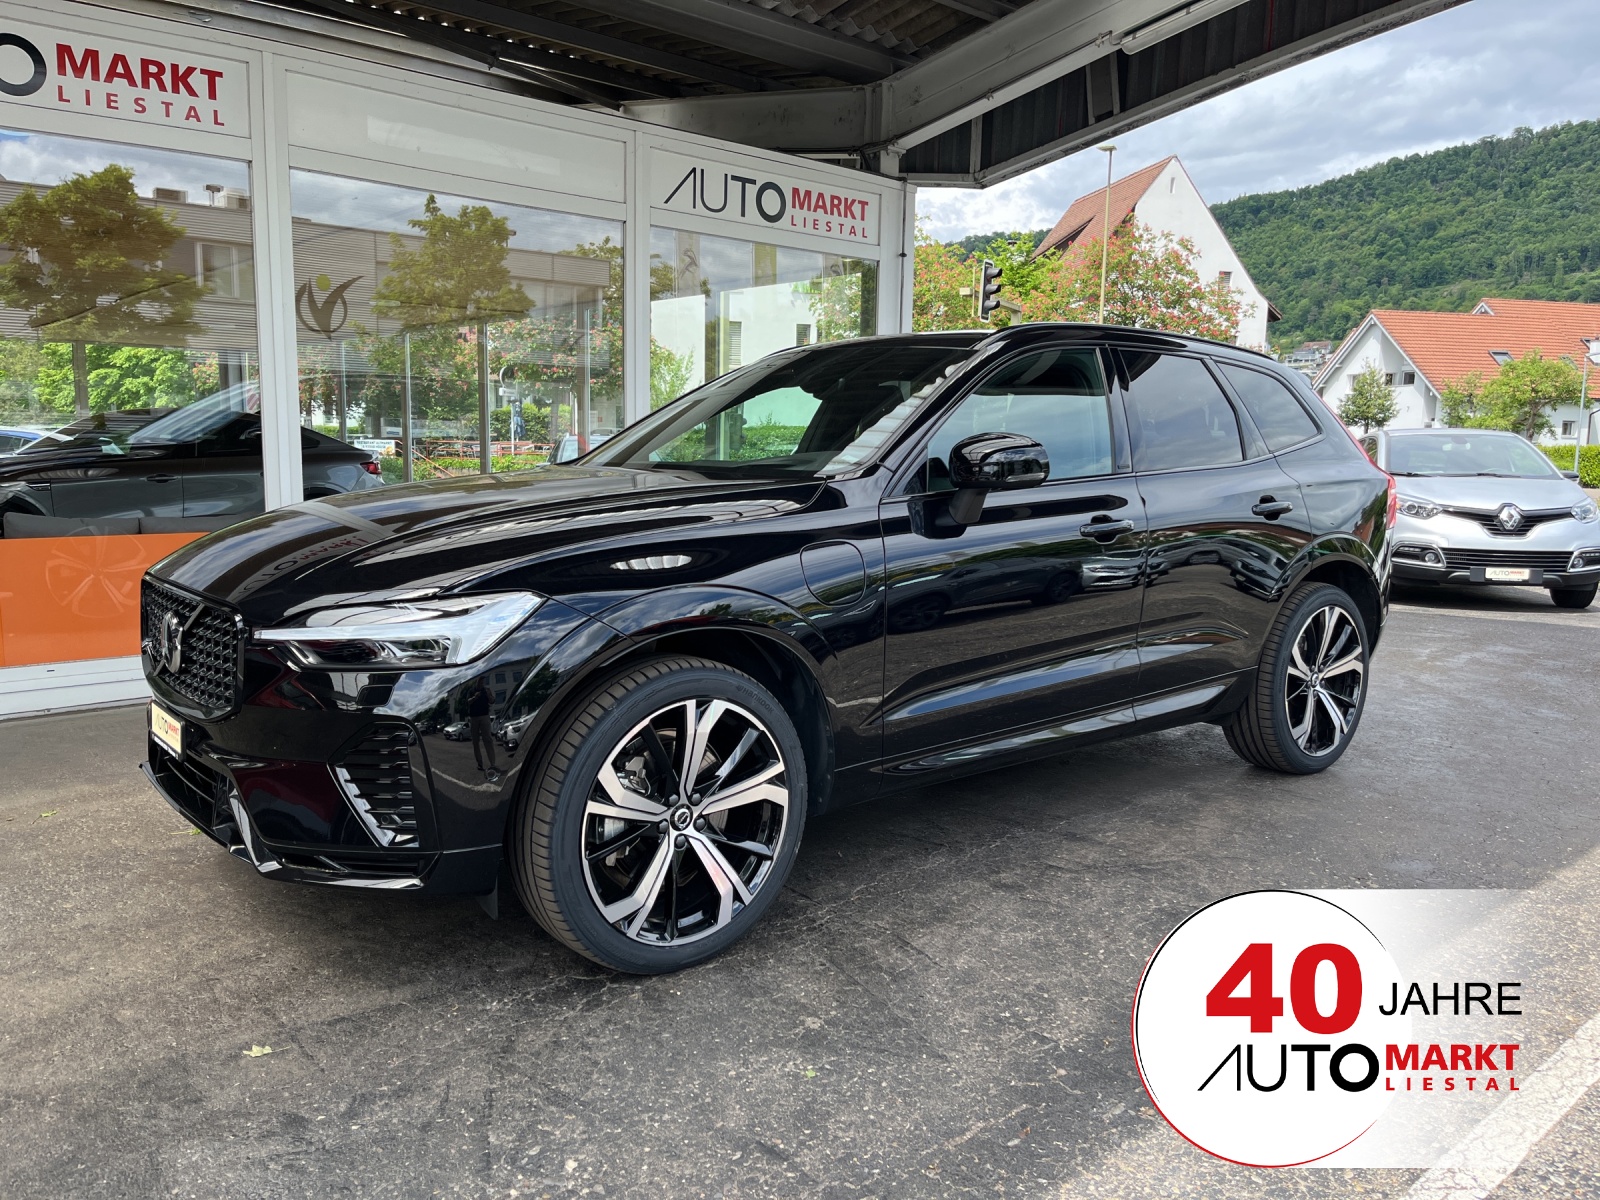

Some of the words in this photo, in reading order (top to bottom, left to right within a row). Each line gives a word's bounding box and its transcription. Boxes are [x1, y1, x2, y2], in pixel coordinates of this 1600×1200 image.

[56, 43, 223, 100] MARKT
[57, 85, 225, 127] LIESTAL
[791, 187, 869, 221] MARKT
[790, 214, 868, 238] LIESTAL
